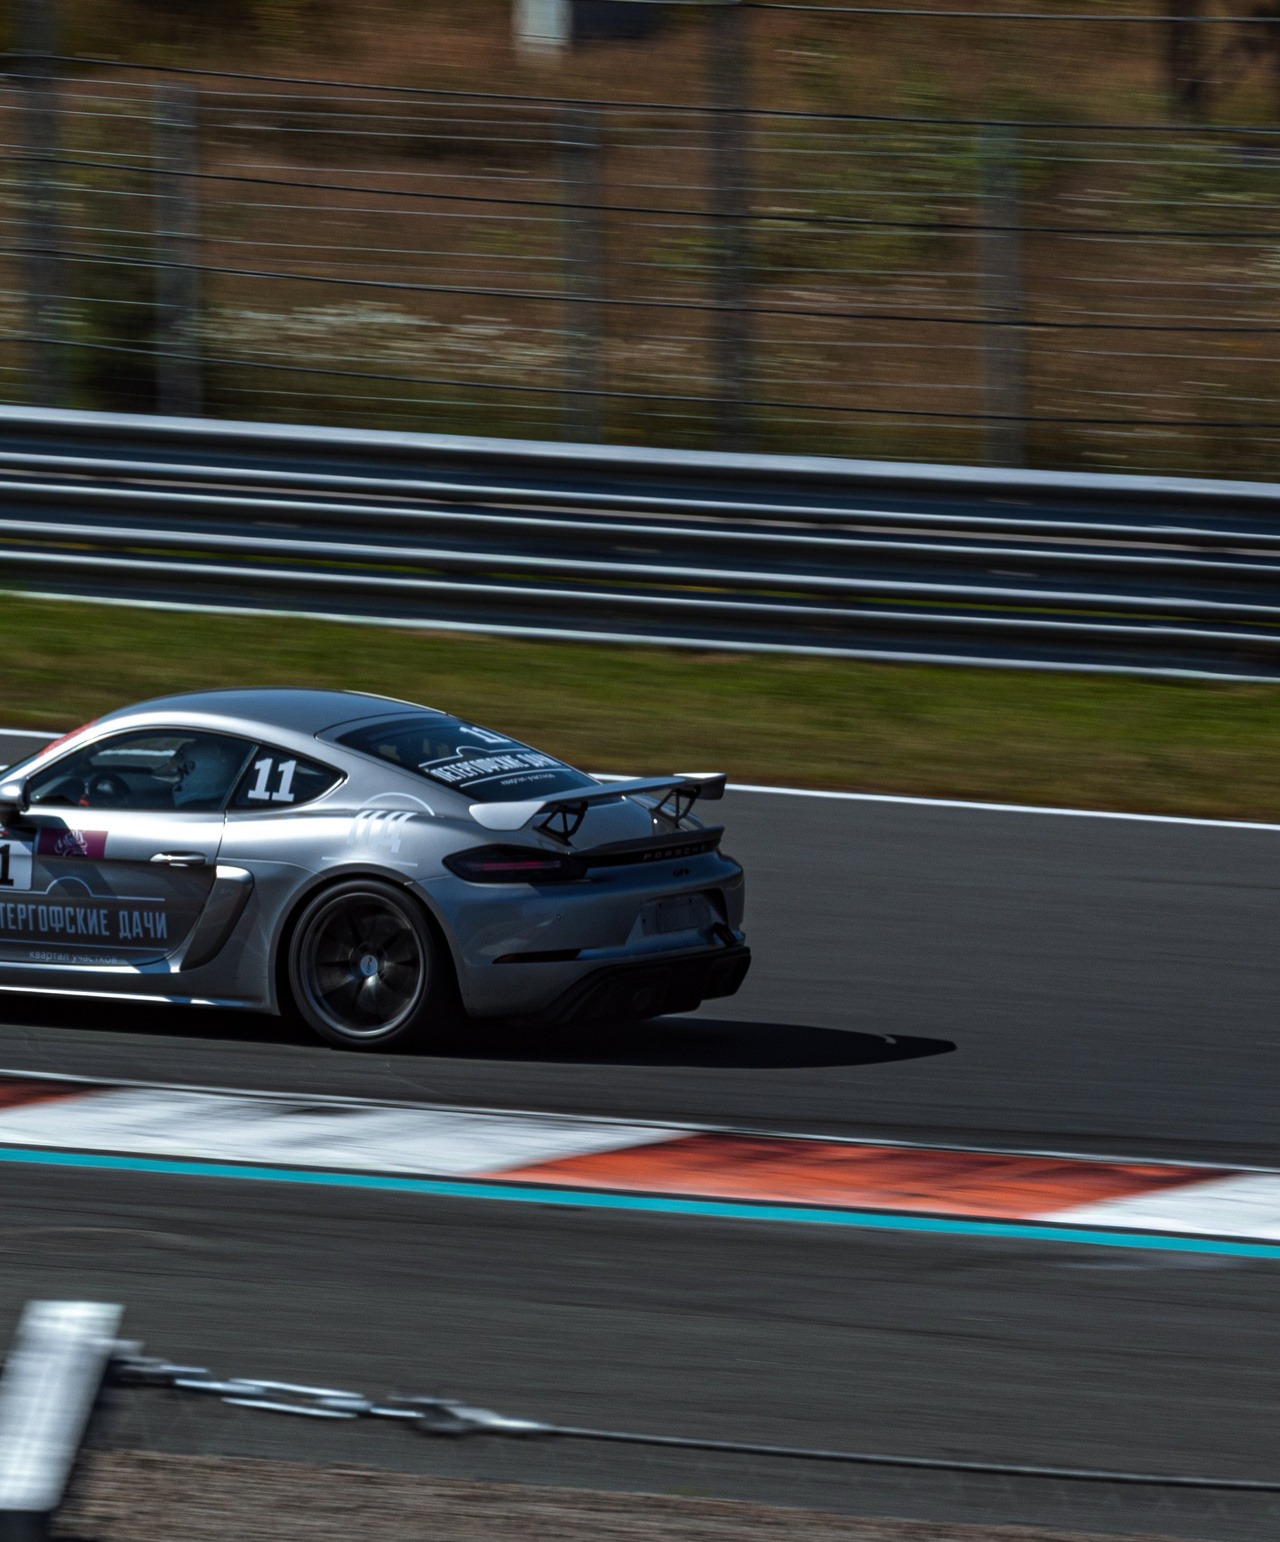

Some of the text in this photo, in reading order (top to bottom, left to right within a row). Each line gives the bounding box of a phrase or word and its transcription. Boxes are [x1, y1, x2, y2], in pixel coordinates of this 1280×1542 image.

[247, 758, 296, 802] 11
[642, 844, 707, 861] PORSCHE
[119, 910, 167, 939] ДАЧИ
[29, 951, 118, 964] квартал участков
